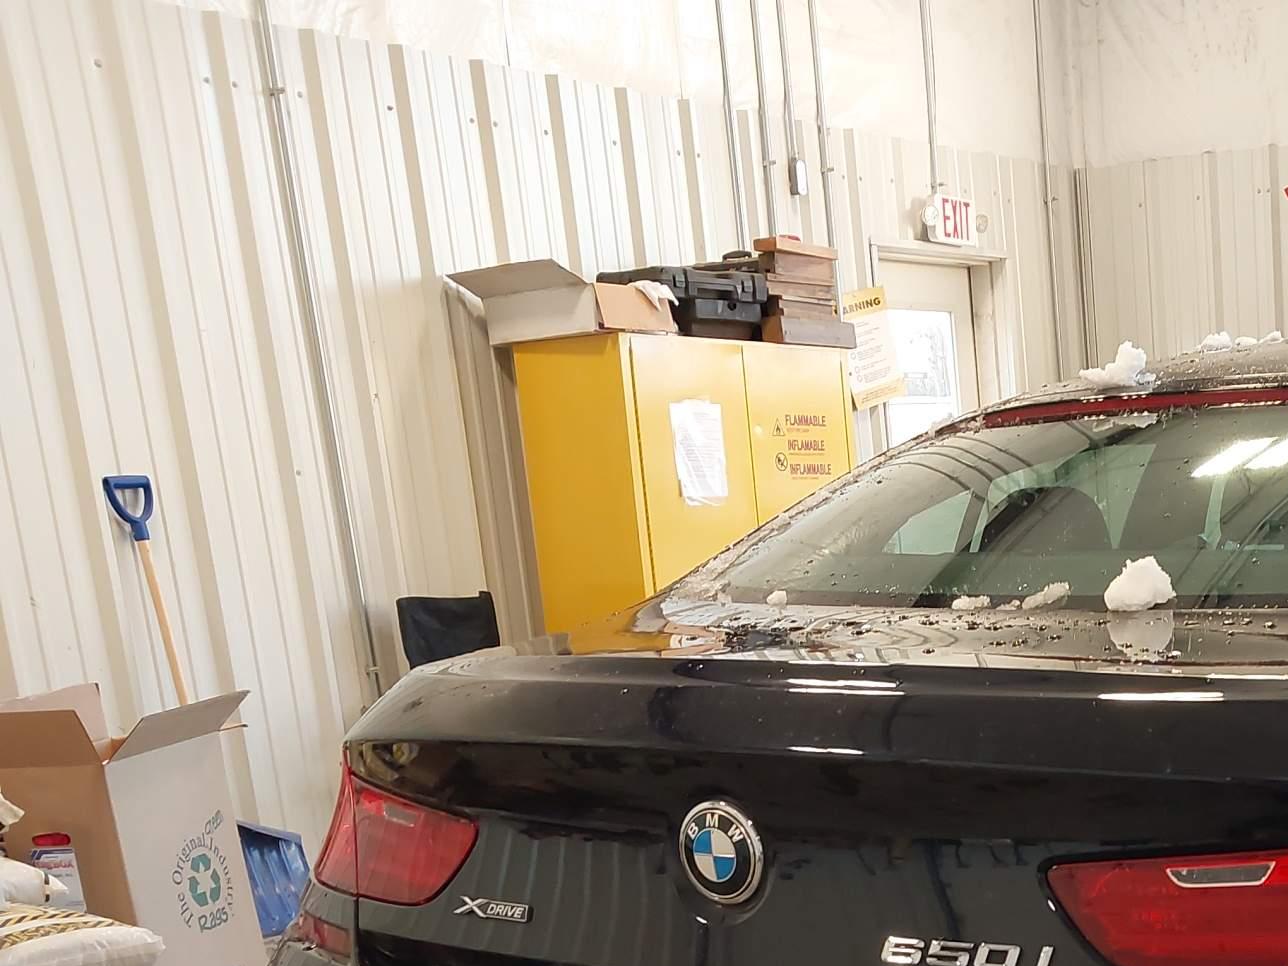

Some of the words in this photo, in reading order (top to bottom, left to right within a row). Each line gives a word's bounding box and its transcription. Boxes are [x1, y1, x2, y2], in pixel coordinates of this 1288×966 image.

[942, 198, 970, 240] EXIT
[842, 297, 881, 315] ARNING
[785, 414, 827, 427] FLAMMABLE
[787, 439, 825, 451] INFLAMABLE
[789, 463, 832, 475] INFLAMMABLE
[687, 813, 744, 843] BMW
[171, 832, 206, 885] Original
